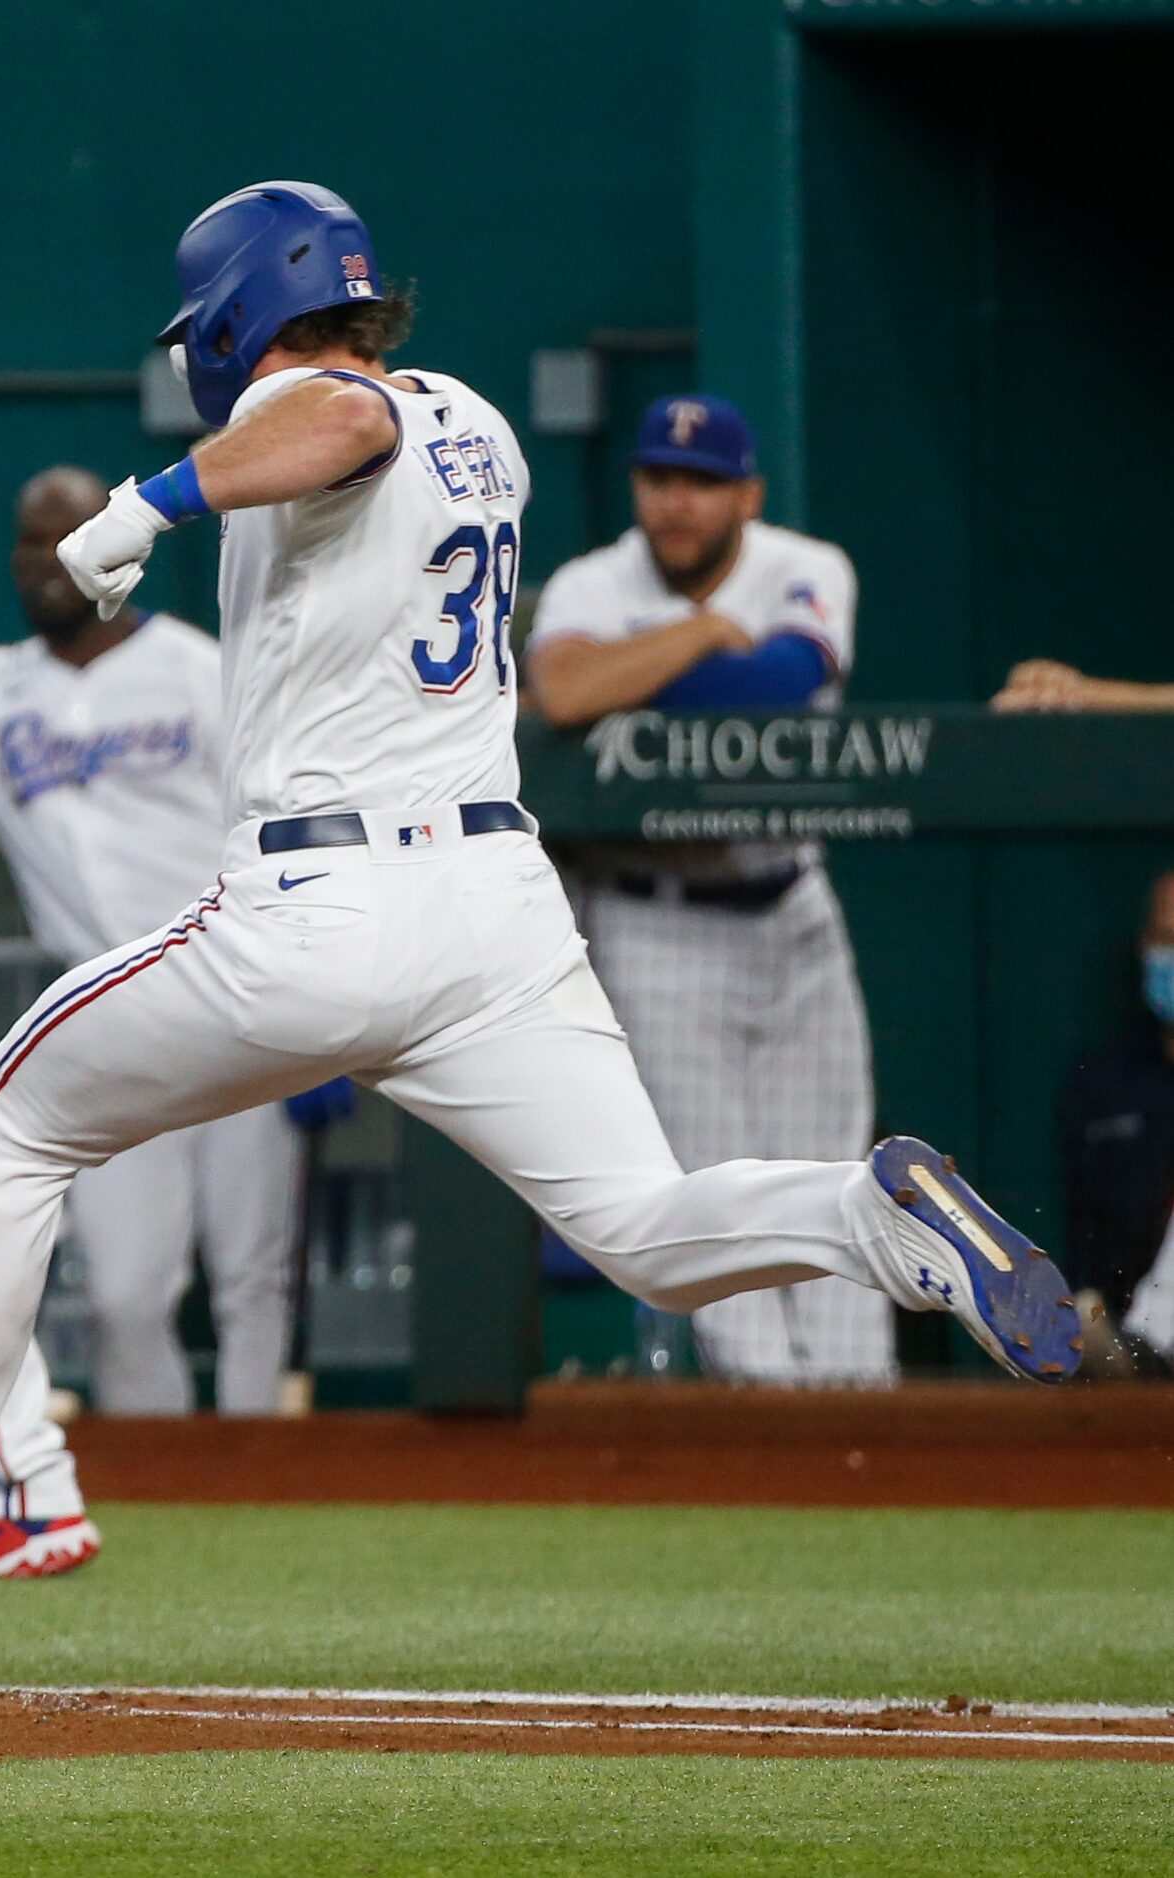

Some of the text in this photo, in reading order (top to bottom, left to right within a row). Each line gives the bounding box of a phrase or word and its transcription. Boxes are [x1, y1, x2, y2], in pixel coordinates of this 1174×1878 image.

[341, 255, 368, 279] 38
[666, 400, 709, 447] T
[410, 521, 518, 696] 38
[588, 710, 934, 782] CHOCTAW
